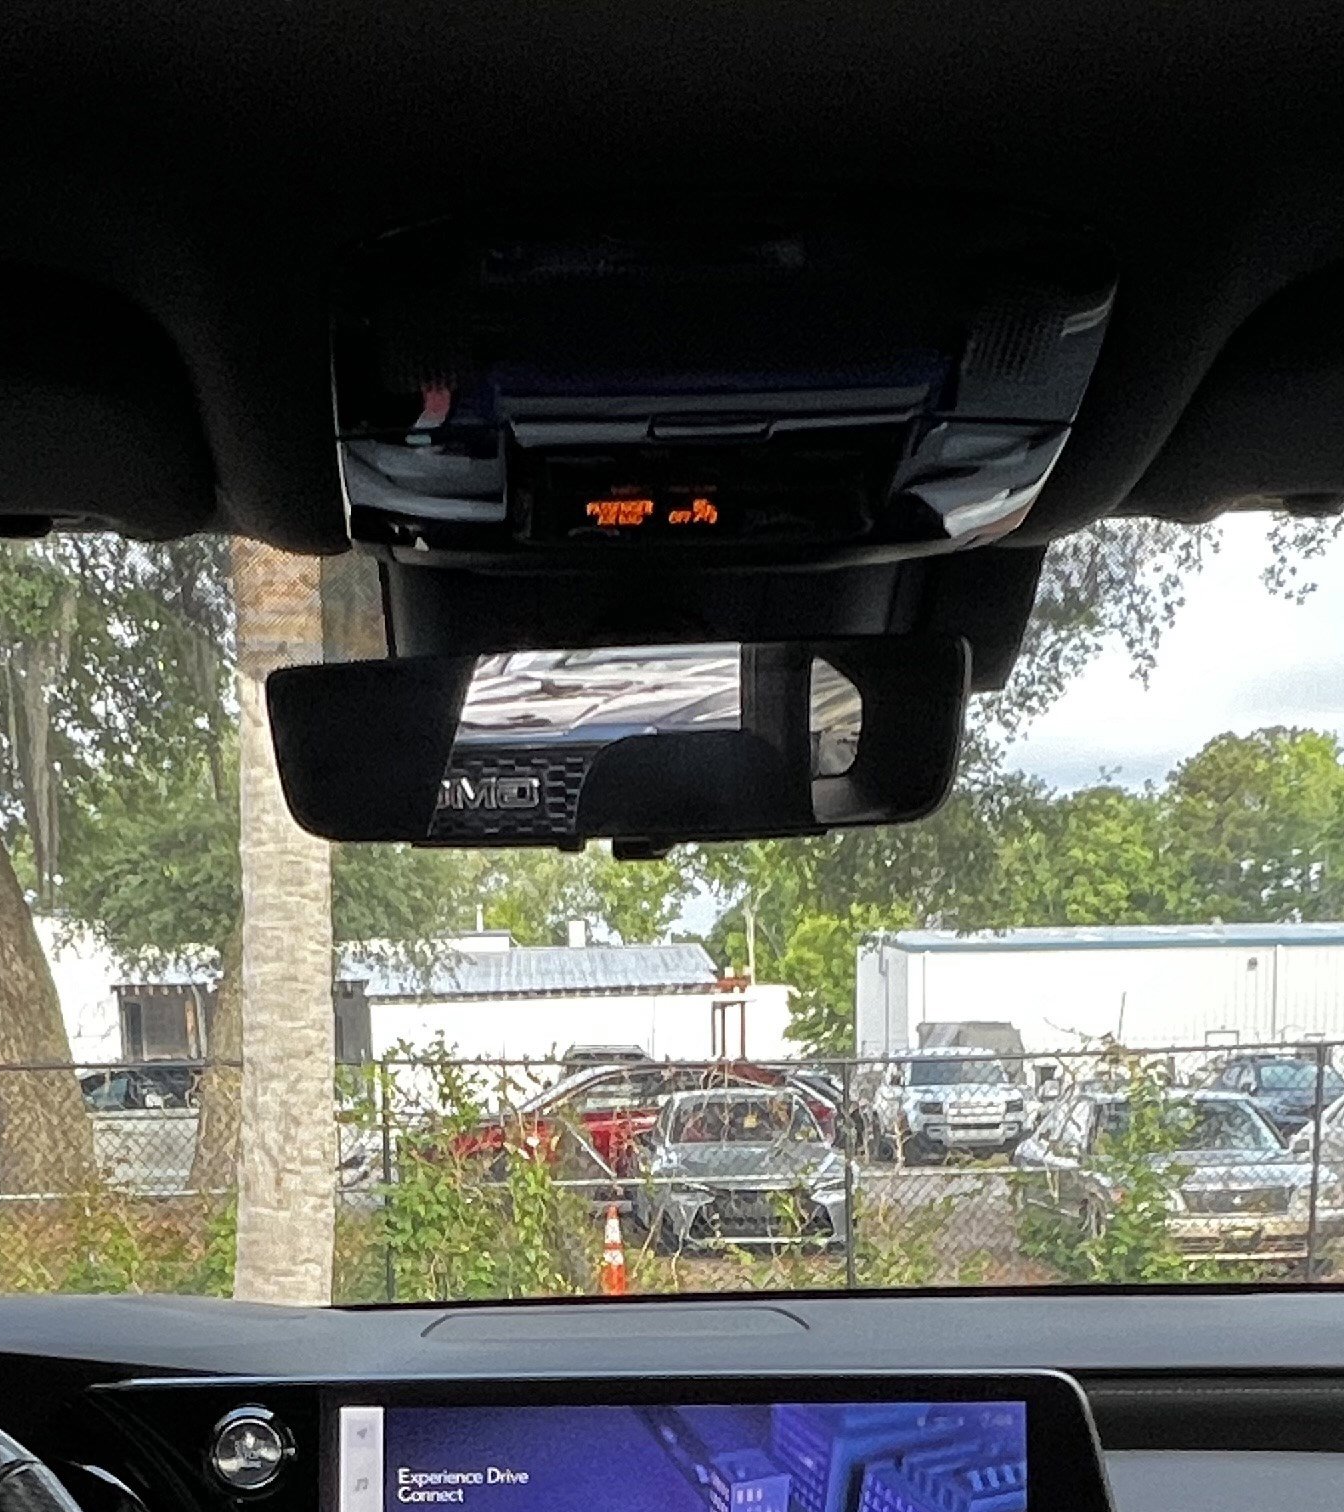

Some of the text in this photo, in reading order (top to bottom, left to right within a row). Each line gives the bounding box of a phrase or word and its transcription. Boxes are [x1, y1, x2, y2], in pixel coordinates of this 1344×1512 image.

[397, 1466, 530, 1488] Experience Drive
[397, 1486, 465, 1503] Connect
